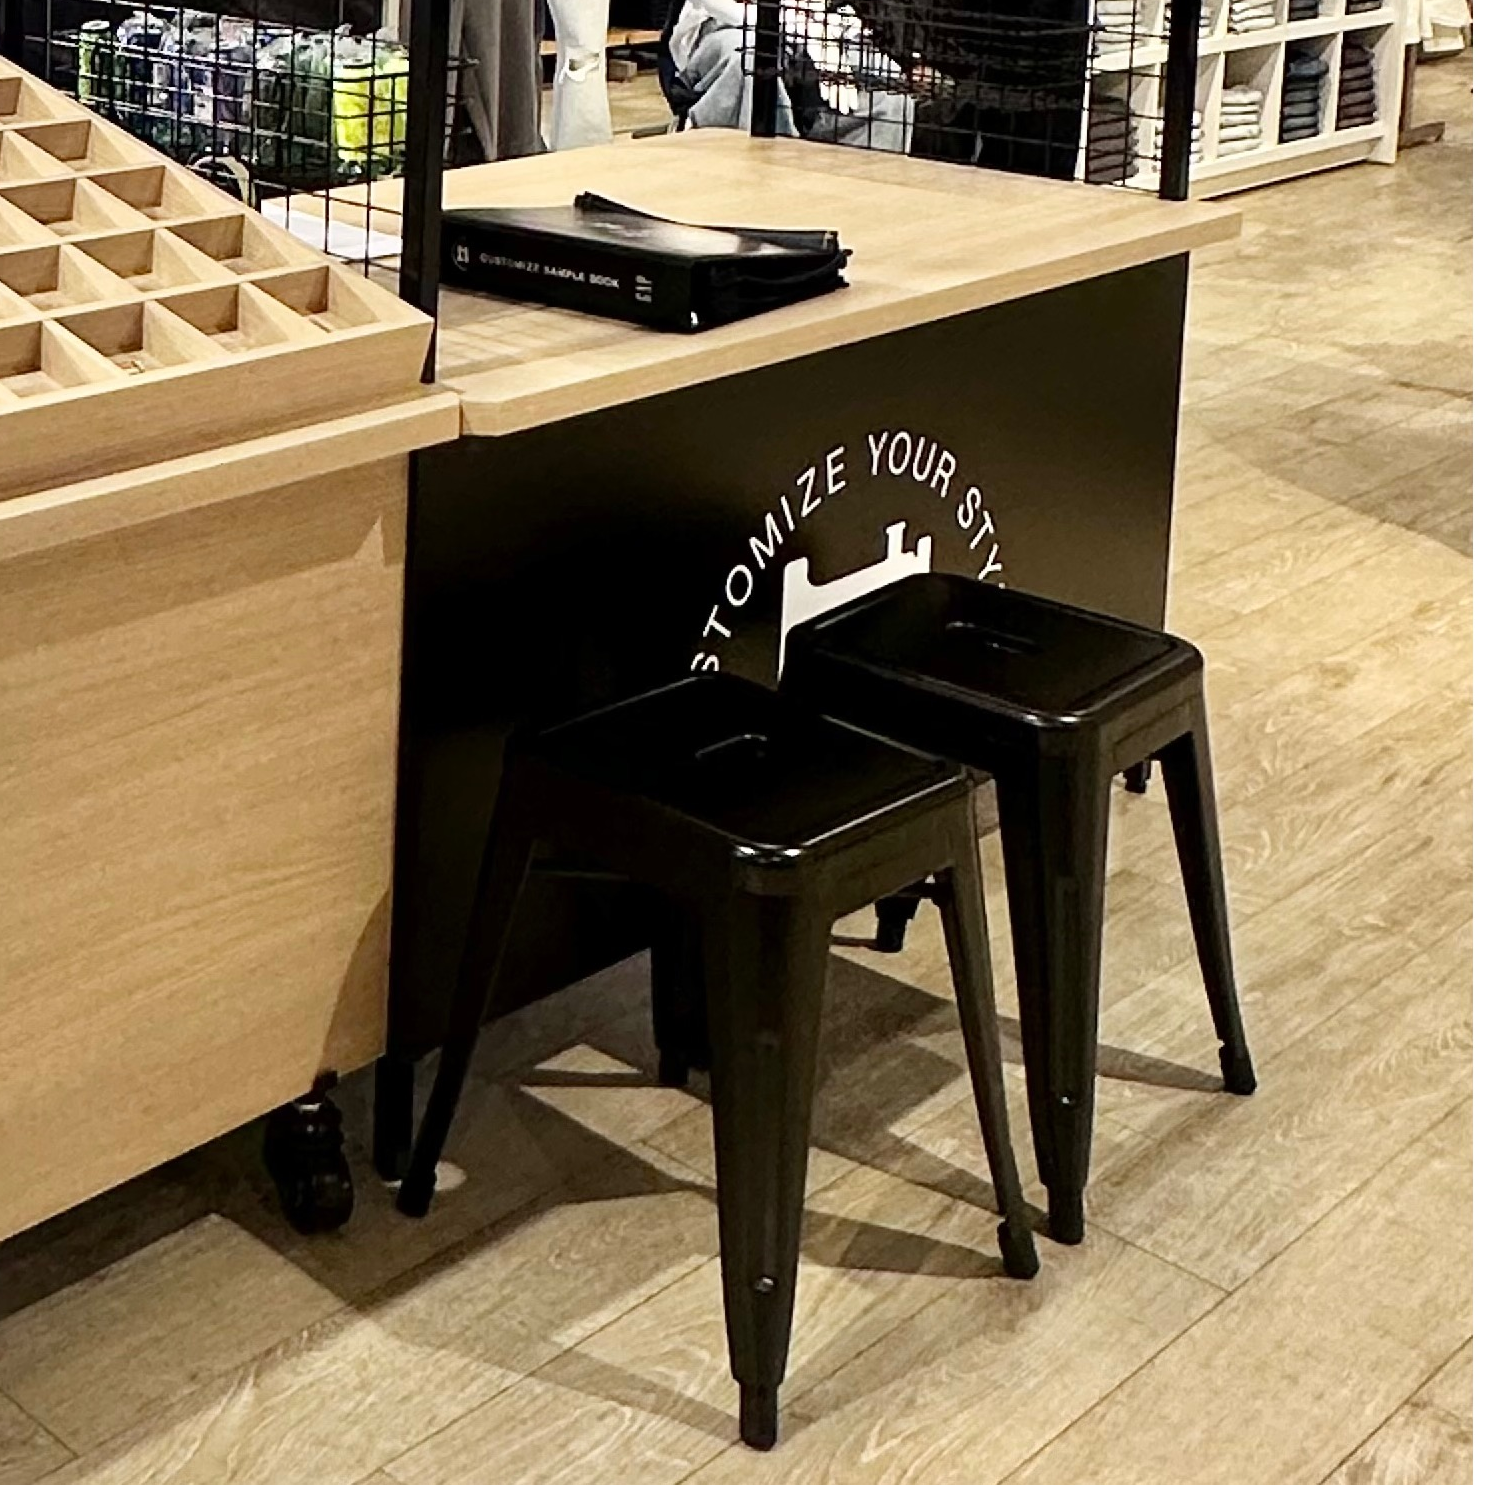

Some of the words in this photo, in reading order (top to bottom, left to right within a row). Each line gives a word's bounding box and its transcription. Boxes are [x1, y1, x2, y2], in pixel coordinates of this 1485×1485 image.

[690, 445, 848, 672] STOMIZE
[867, 429, 957, 498] YOUR
[956, 485, 1006, 589] STY
